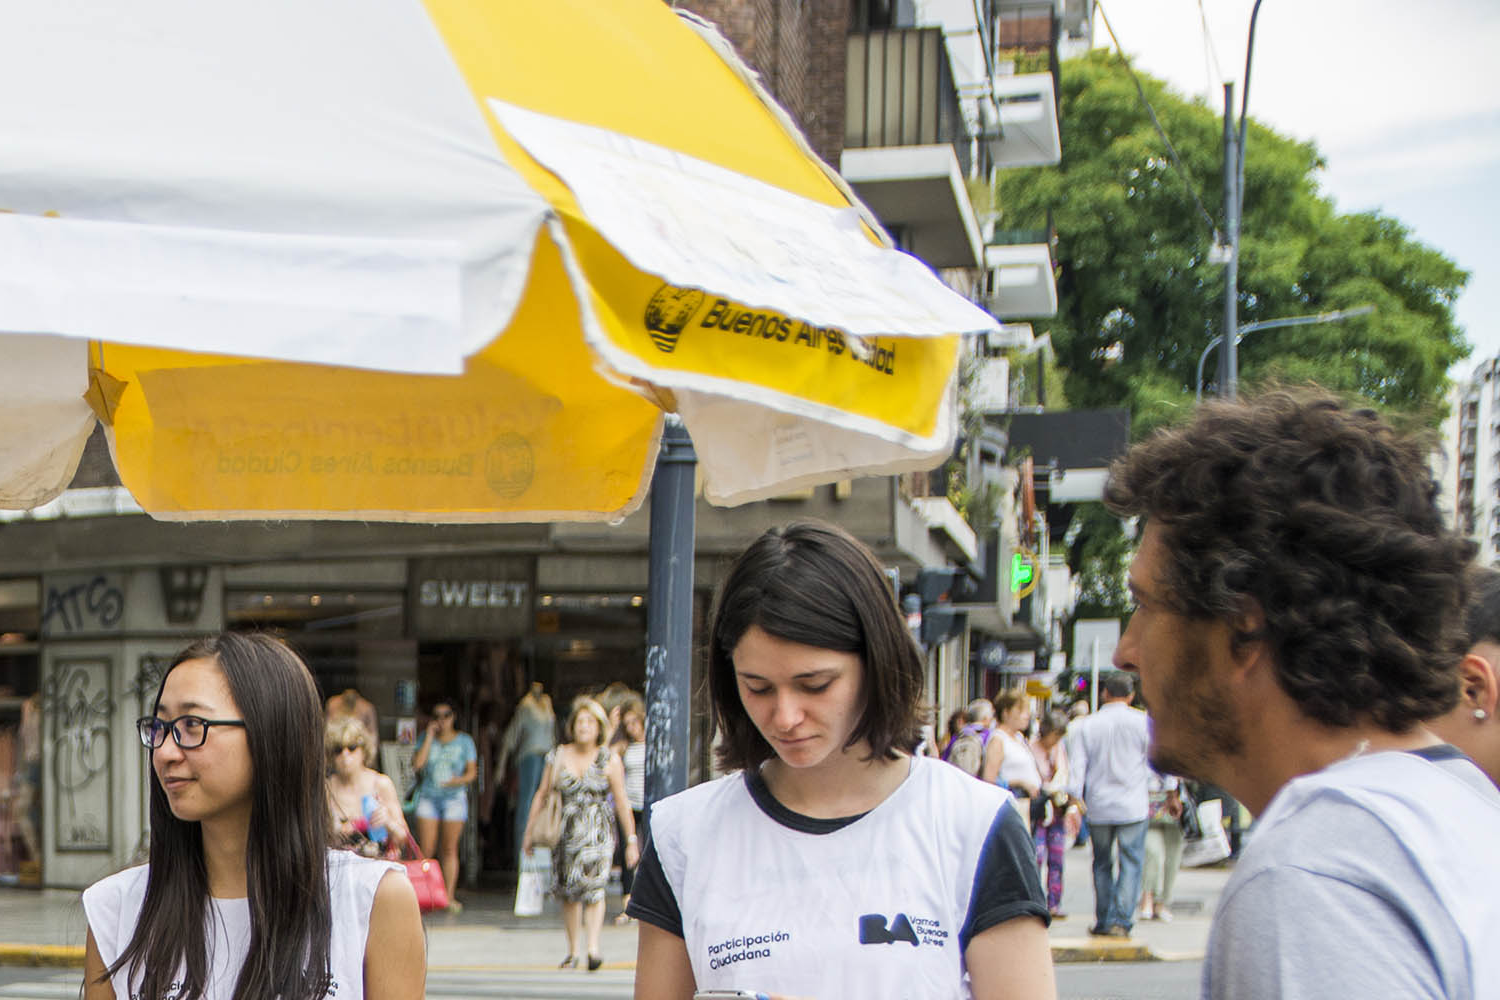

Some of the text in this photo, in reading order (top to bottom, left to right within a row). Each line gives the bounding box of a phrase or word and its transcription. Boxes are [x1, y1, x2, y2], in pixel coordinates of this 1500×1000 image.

[700, 298, 792, 343] Buenos
[794, 320, 847, 356] Aires
[420, 581, 529, 607] SWEET
[858, 912, 921, 948] BA
[909, 916, 941, 928] Vamos
[916, 926, 949, 939] Buenos
[708, 930, 791, 957] Participación
[922, 935, 945, 948] Aires
[709, 947, 772, 971] Ciudadana
